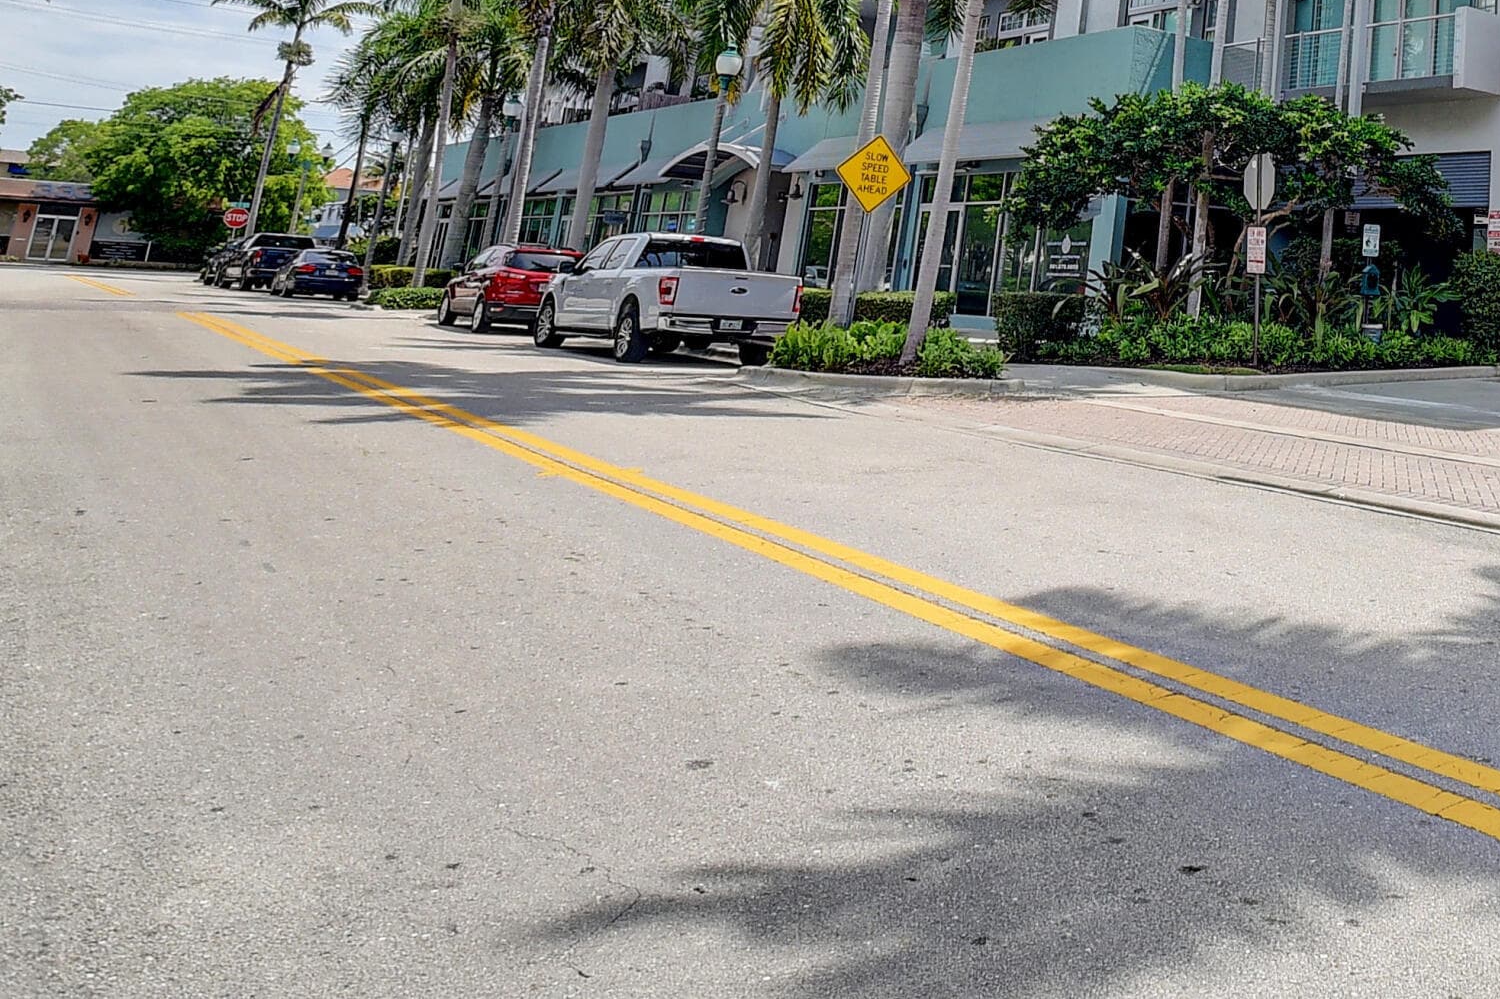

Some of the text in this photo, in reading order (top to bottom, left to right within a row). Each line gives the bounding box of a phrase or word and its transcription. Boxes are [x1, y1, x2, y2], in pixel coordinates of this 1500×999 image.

[865, 151, 889, 162] SLOW
[862, 162, 889, 173] SPEED
[861, 173, 887, 184] TABLE
[857, 184, 888, 195] AHEAD
[226, 213, 249, 222] STOP
